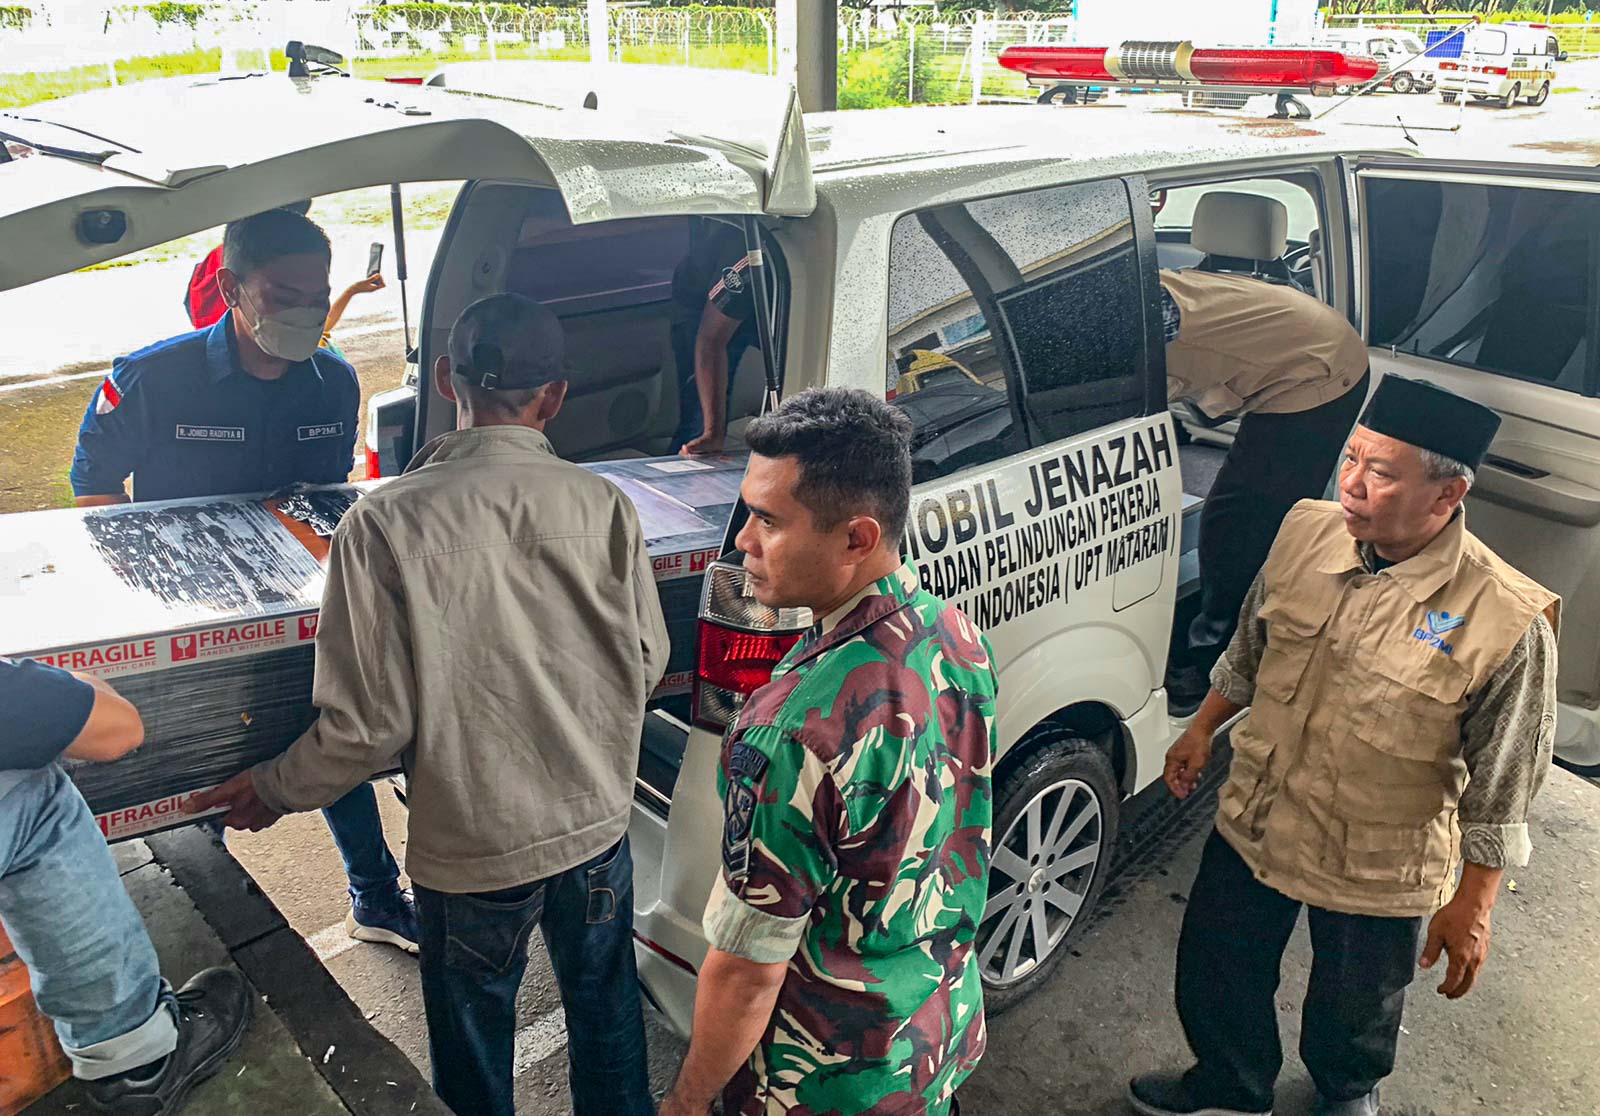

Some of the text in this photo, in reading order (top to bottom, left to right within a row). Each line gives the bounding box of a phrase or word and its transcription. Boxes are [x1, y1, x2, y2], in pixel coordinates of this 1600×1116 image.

[309, 427, 337, 436] BP2MI
[1025, 422, 1172, 517] JENAZAH
[919, 478, 1161, 600] BADAN PELINDUNGAN PEKERJA
[975, 563, 1060, 632] INDONESIA
[1075, 545, 1102, 591] UPT
[1106, 514, 1169, 577] MATARAM
[200, 620, 285, 648] FRAGILE
[200, 638, 286, 657] HANDLE WITH CARE
[58, 640, 156, 668] FRAGILE
[103, 664, 128, 674] WITH
[131, 660, 157, 670] CARE
